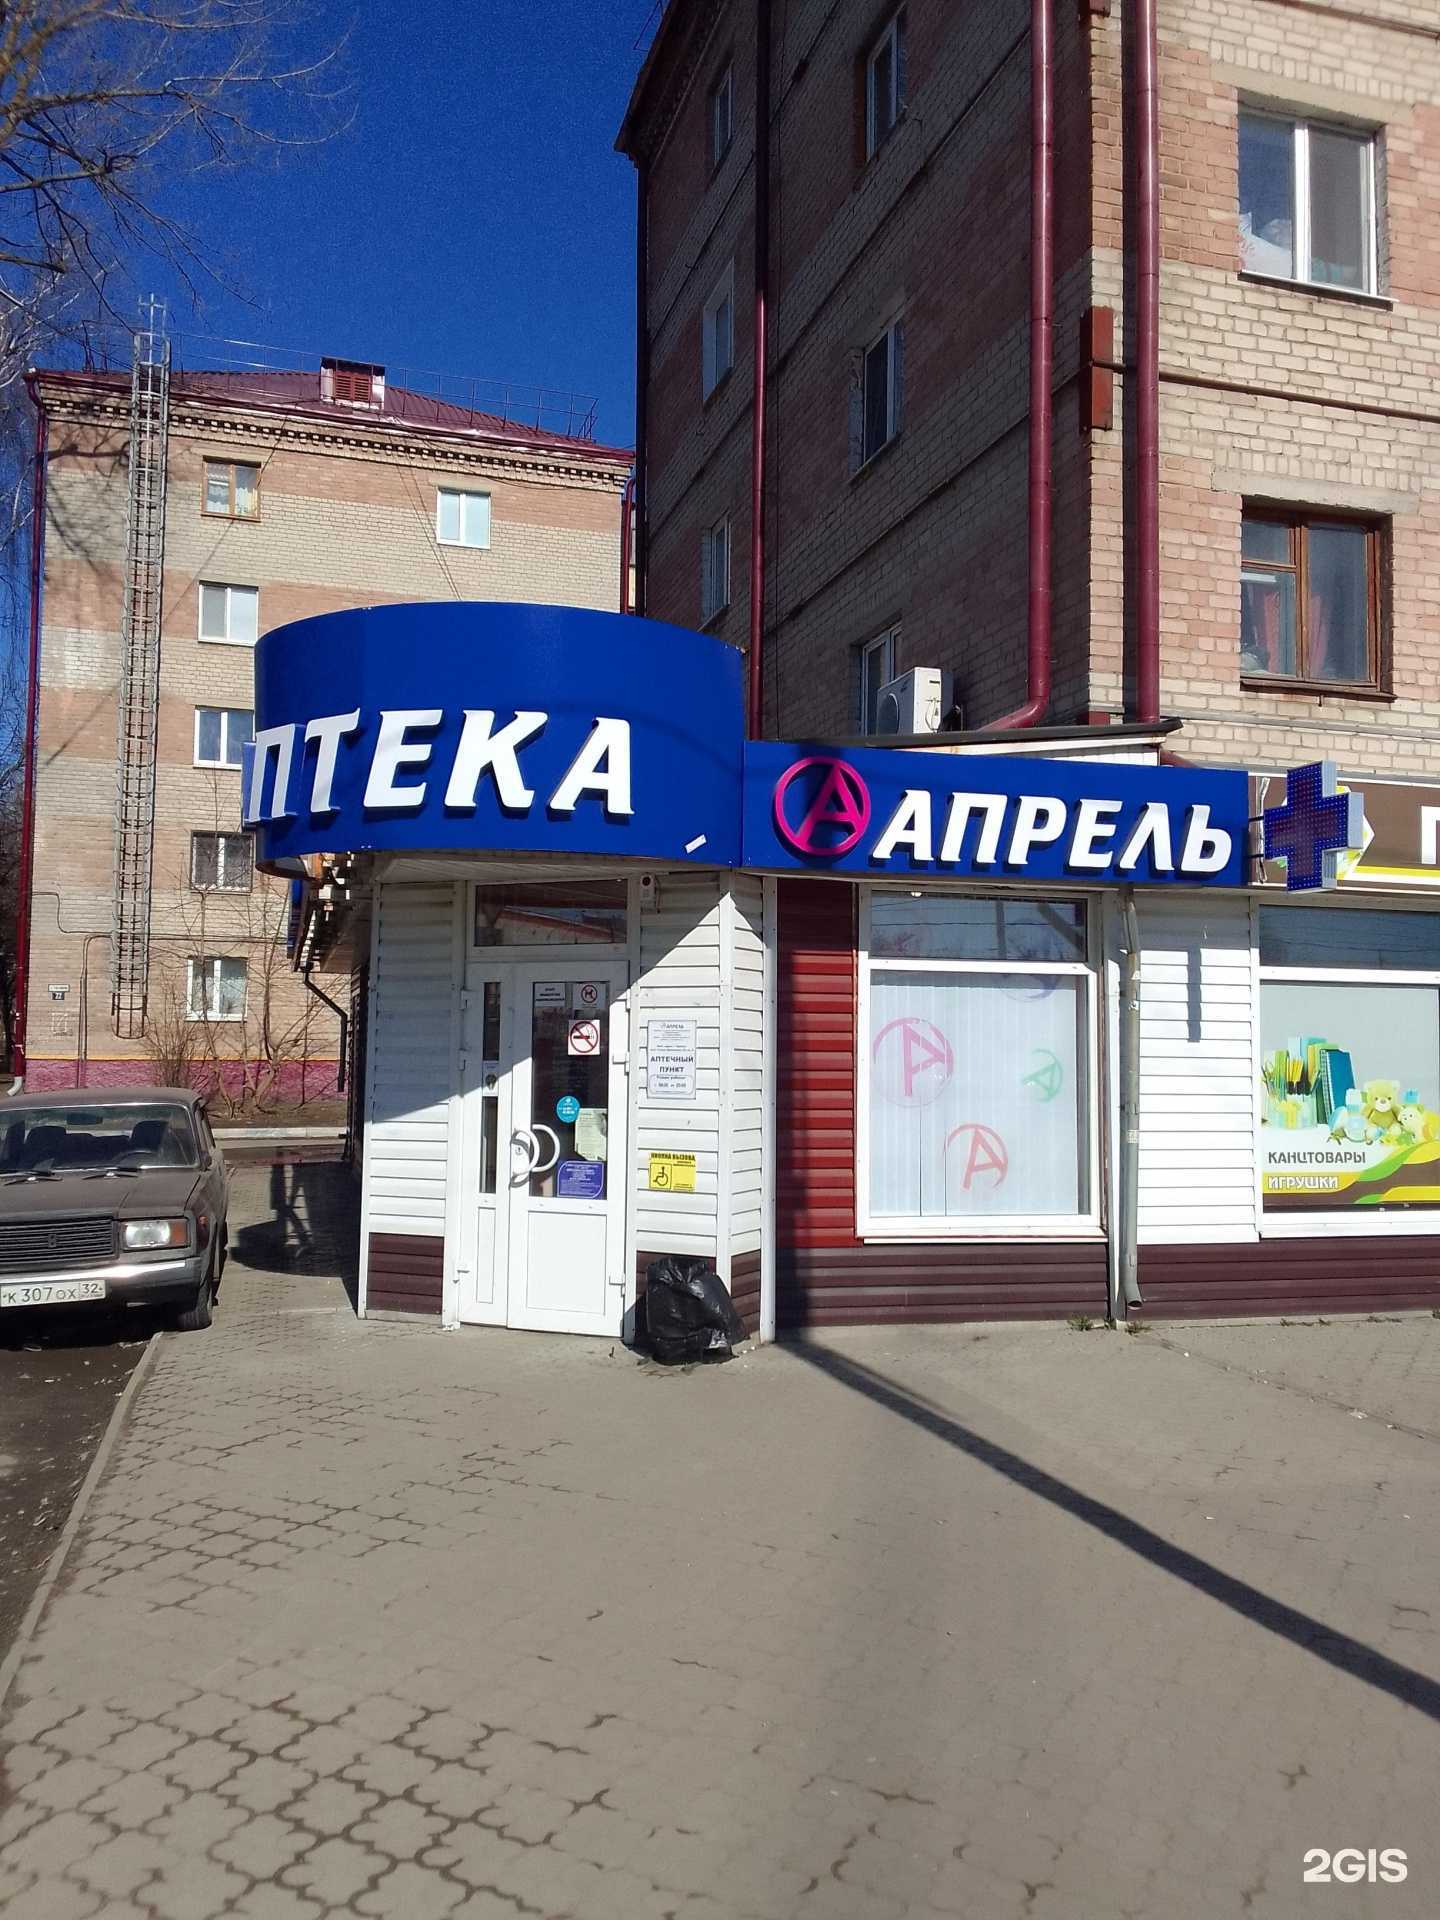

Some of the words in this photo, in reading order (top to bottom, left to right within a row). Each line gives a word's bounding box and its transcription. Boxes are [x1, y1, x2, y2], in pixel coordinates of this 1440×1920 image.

[873, 789, 1232, 873] АПРЕЛЬ
[650, 1054, 694, 1063] АПТЕЧНЫЙ
[1268, 1151, 1366, 1164] КАНЦТОВАРЫ
[1267, 1175, 1339, 1190] ИГРУШКИ
